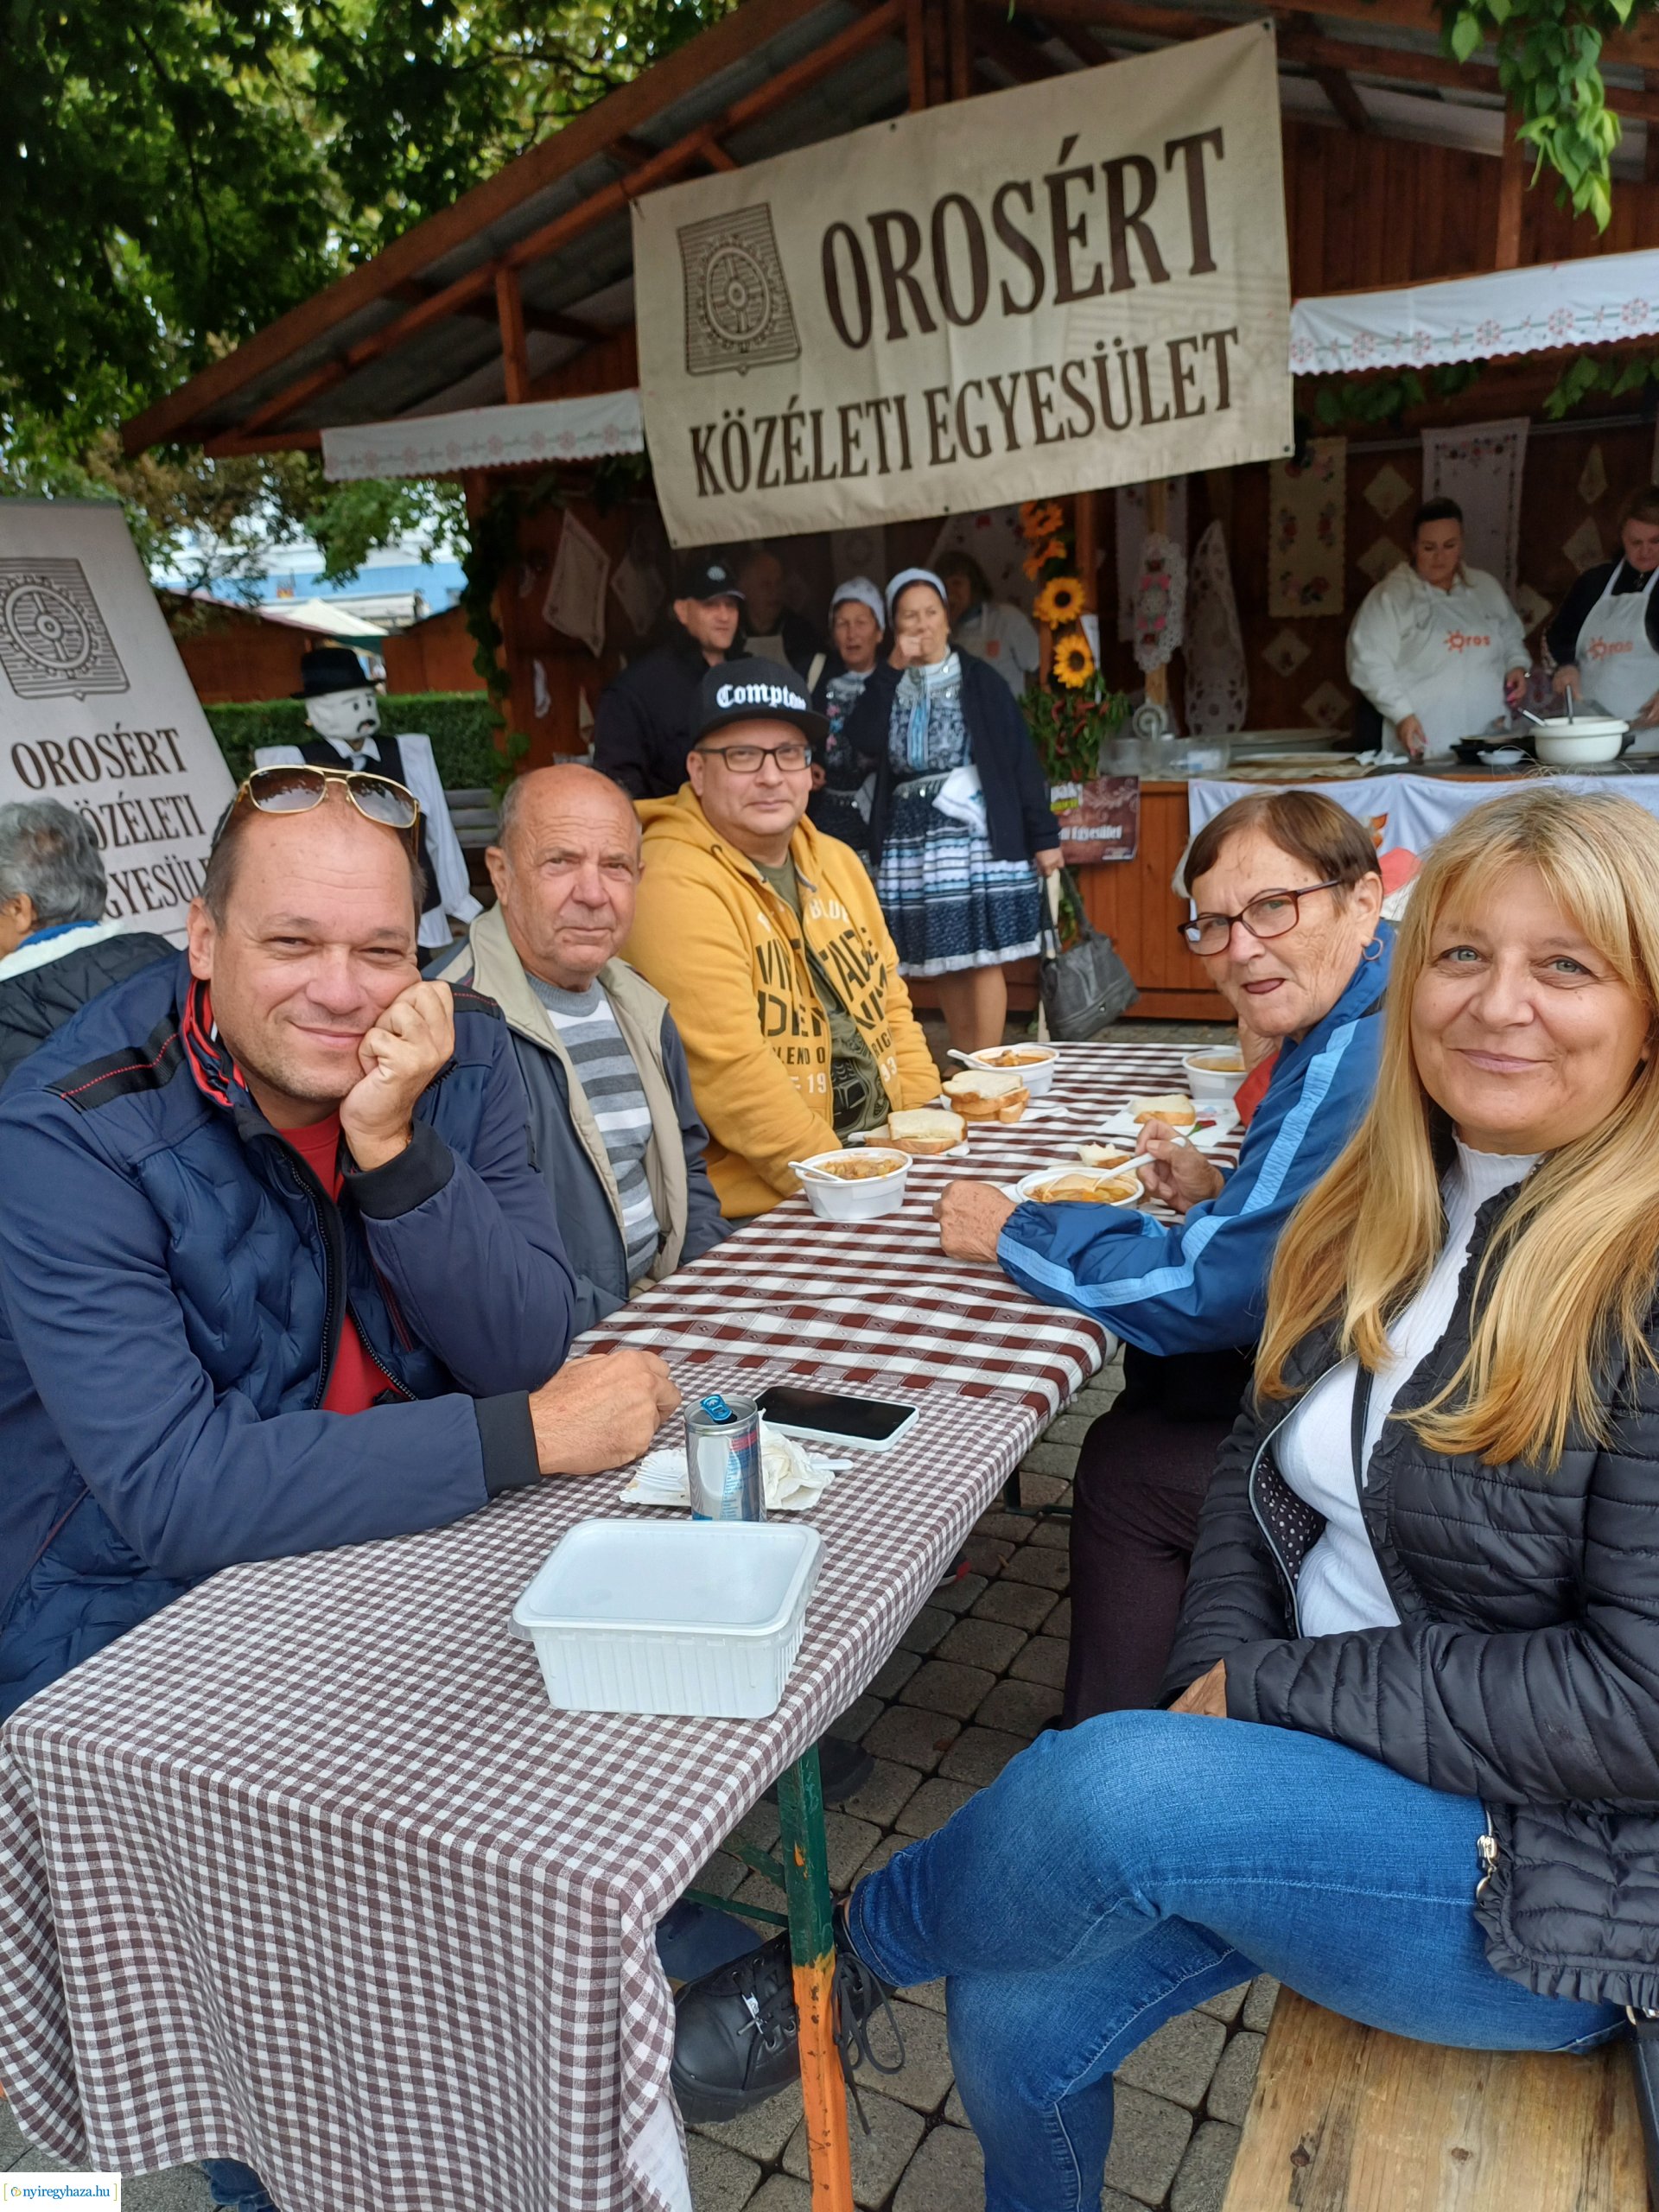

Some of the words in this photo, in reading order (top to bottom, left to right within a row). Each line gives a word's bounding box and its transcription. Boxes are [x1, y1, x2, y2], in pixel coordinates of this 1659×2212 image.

[822, 127, 1225, 349] OROSÉRT
[690, 395, 913, 498] KÖZÉLETI
[922, 327, 1238, 464] EGYESÜLET
[11, 721, 187, 790] OROSÉRT
[74, 791, 206, 850] ÖZÉLETI
